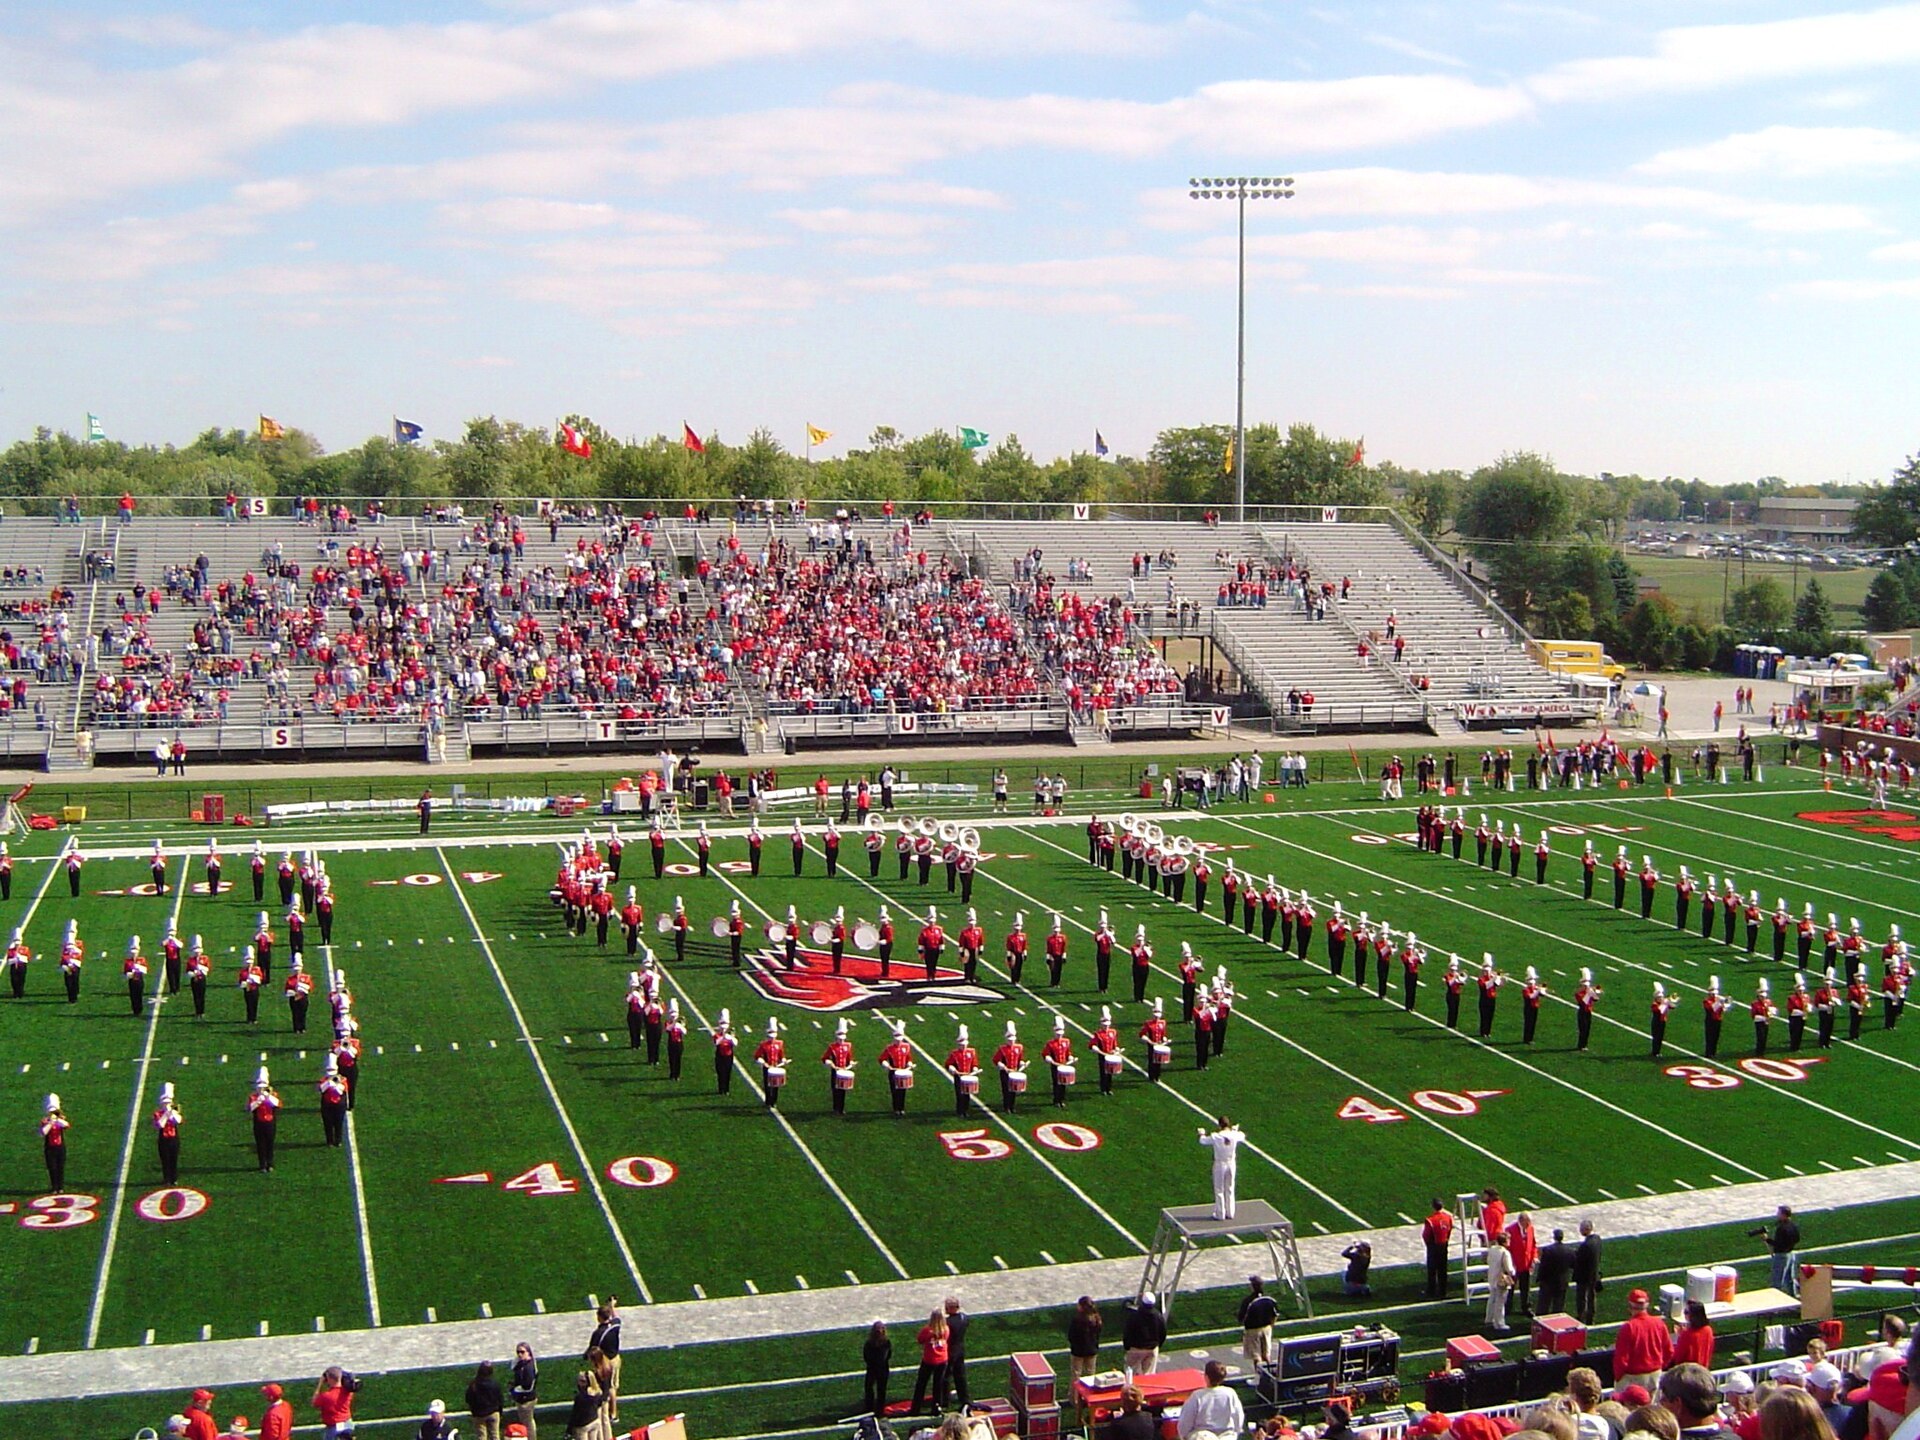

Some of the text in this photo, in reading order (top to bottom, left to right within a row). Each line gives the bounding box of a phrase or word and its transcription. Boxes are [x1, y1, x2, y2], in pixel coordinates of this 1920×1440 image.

[254, 500, 264, 513] S
[1076, 506, 1086, 518] V
[1325, 509, 1335, 520] W
[1214, 709, 1225, 724] V
[1463, 704, 1476, 717] W
[600, 723, 611, 738] T
[902, 716, 914, 731] U
[276, 729, 287, 745] S
